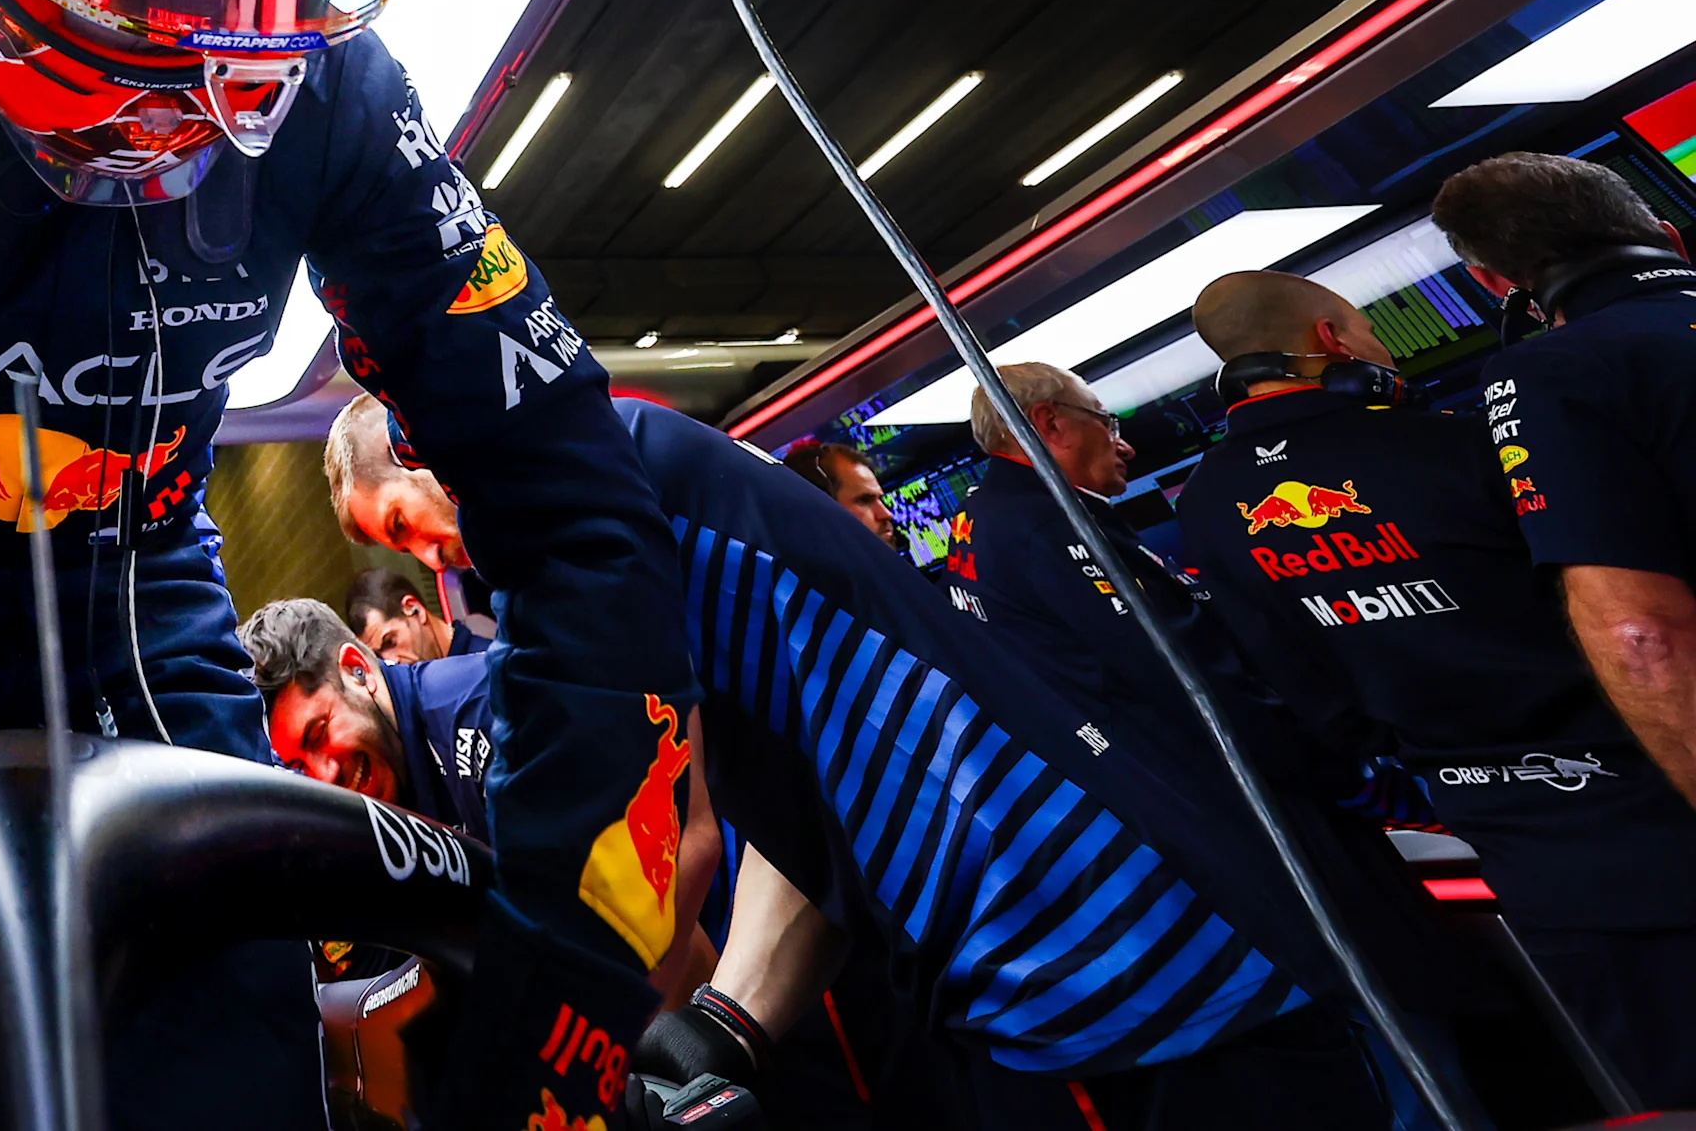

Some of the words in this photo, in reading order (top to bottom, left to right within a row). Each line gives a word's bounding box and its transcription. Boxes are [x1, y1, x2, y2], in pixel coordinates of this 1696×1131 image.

[1631, 268, 1696, 281] HON
[129, 294, 269, 330] HONDA
[1250, 534, 1342, 581] Red
[1330, 522, 1420, 567] Bull
[1301, 585, 1416, 626] Mobil
[456, 727, 475, 780] VISA
